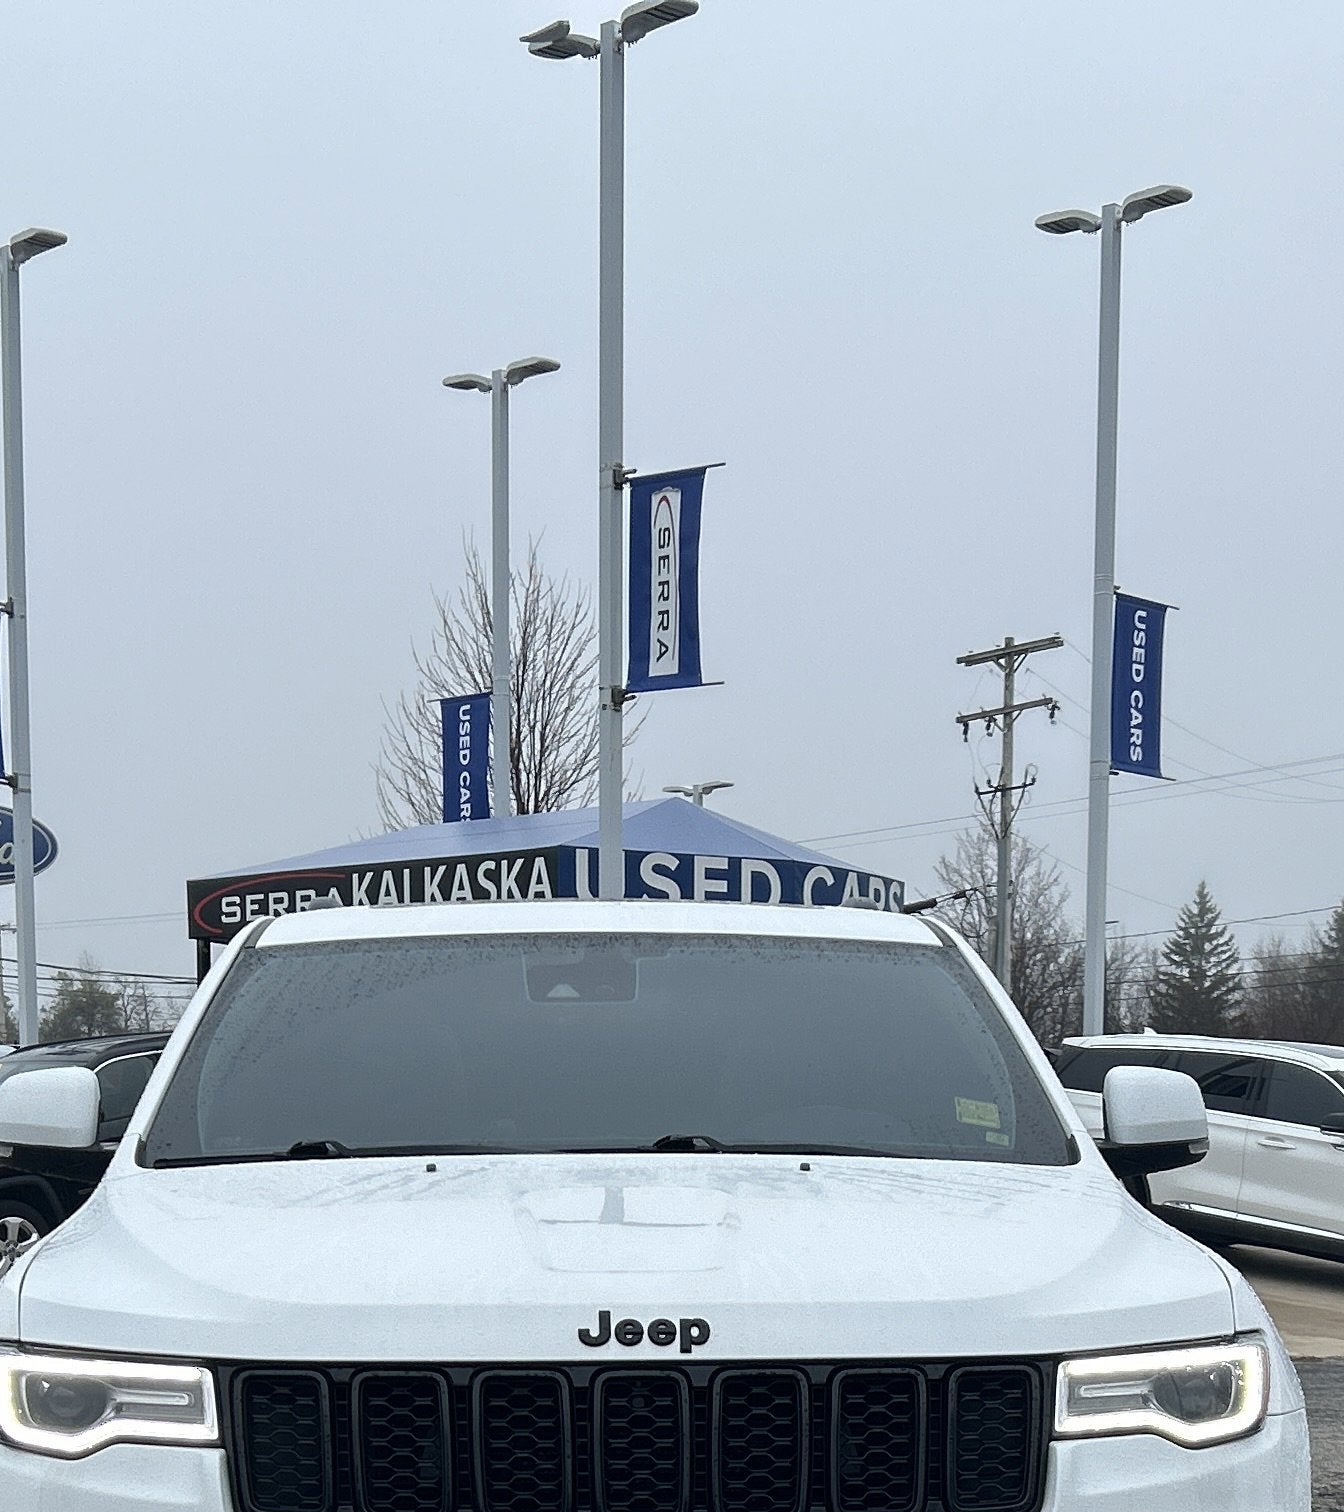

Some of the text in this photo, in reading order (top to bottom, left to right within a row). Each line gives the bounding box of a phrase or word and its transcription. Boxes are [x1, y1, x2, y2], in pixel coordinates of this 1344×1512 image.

[656, 527, 671, 662] SERRA
[1129, 609, 1147, 762] USED CARS
[459, 704, 472, 821] USED CAR
[578, 1310, 710, 1353] Jeep
